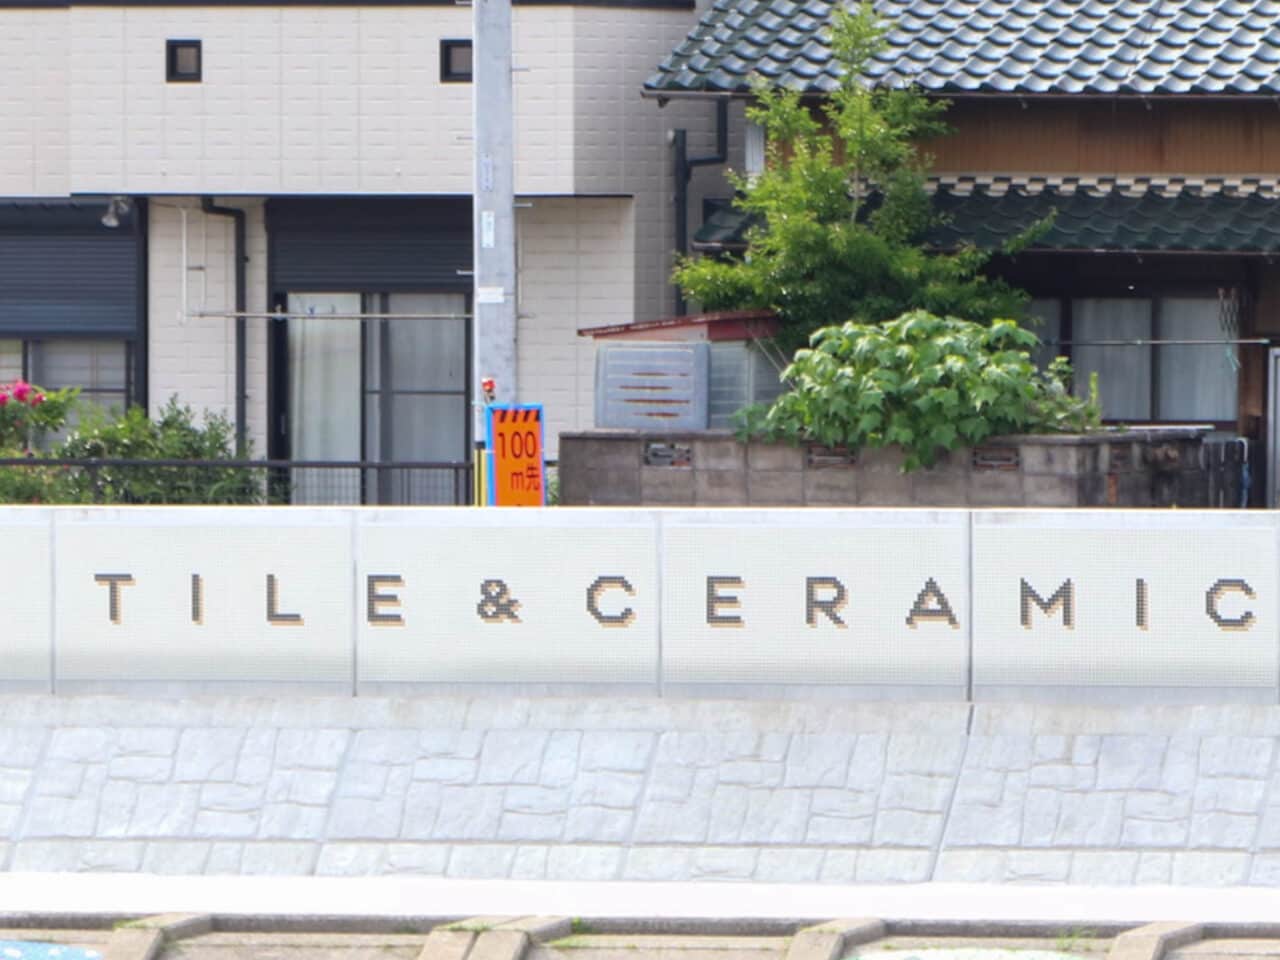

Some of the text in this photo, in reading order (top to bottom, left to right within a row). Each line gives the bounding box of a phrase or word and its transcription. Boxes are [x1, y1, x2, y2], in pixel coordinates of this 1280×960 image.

[498, 431, 537, 459] 100
[94, 573, 405, 626] TILE
[476, 579, 523, 624] &
[585, 575, 1257, 632] CERAMIC
